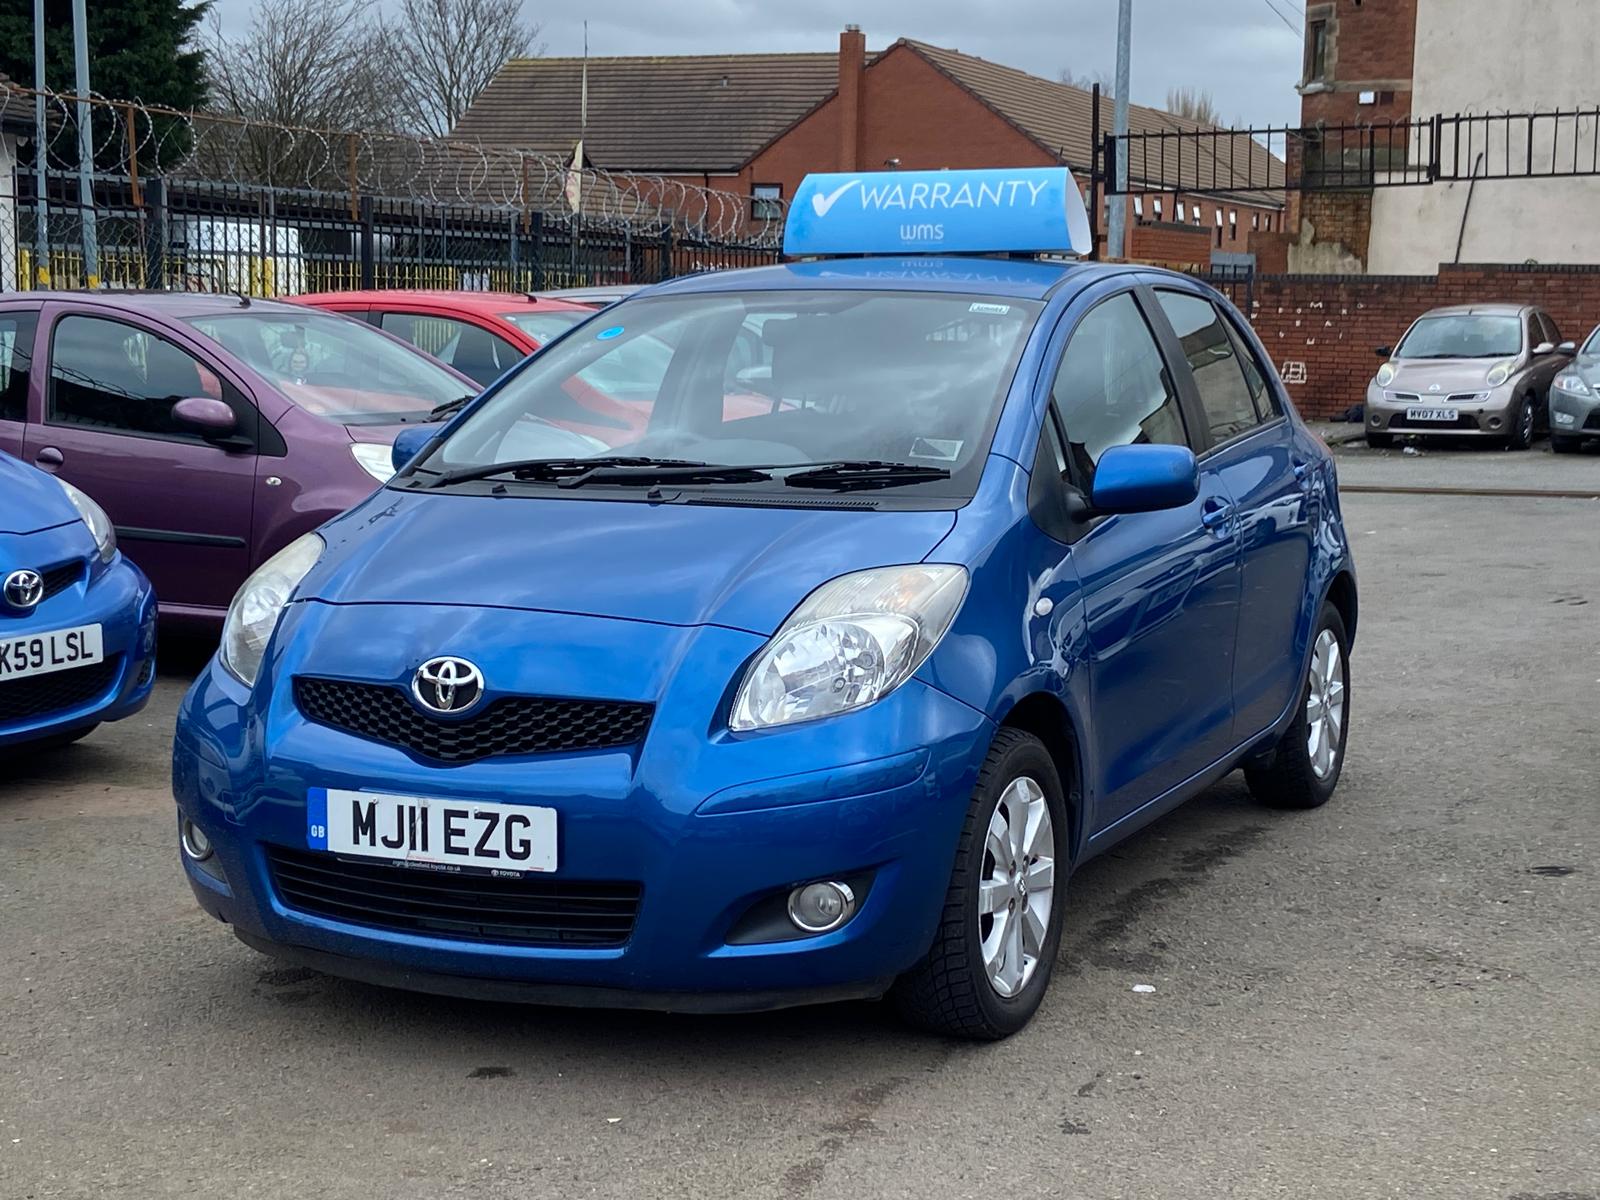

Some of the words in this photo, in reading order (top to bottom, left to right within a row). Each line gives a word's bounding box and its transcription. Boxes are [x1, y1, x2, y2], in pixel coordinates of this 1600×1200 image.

[860, 179, 1048, 210] WARRANTY
[900, 224, 944, 241] wms
[0, 638, 44, 675] K59
[51, 631, 93, 665] LSL
[311, 824, 325, 838] GB
[352, 799, 429, 852] MJ11
[444, 808, 532, 861] EZG
[499, 870, 520, 878] TOYOTA
